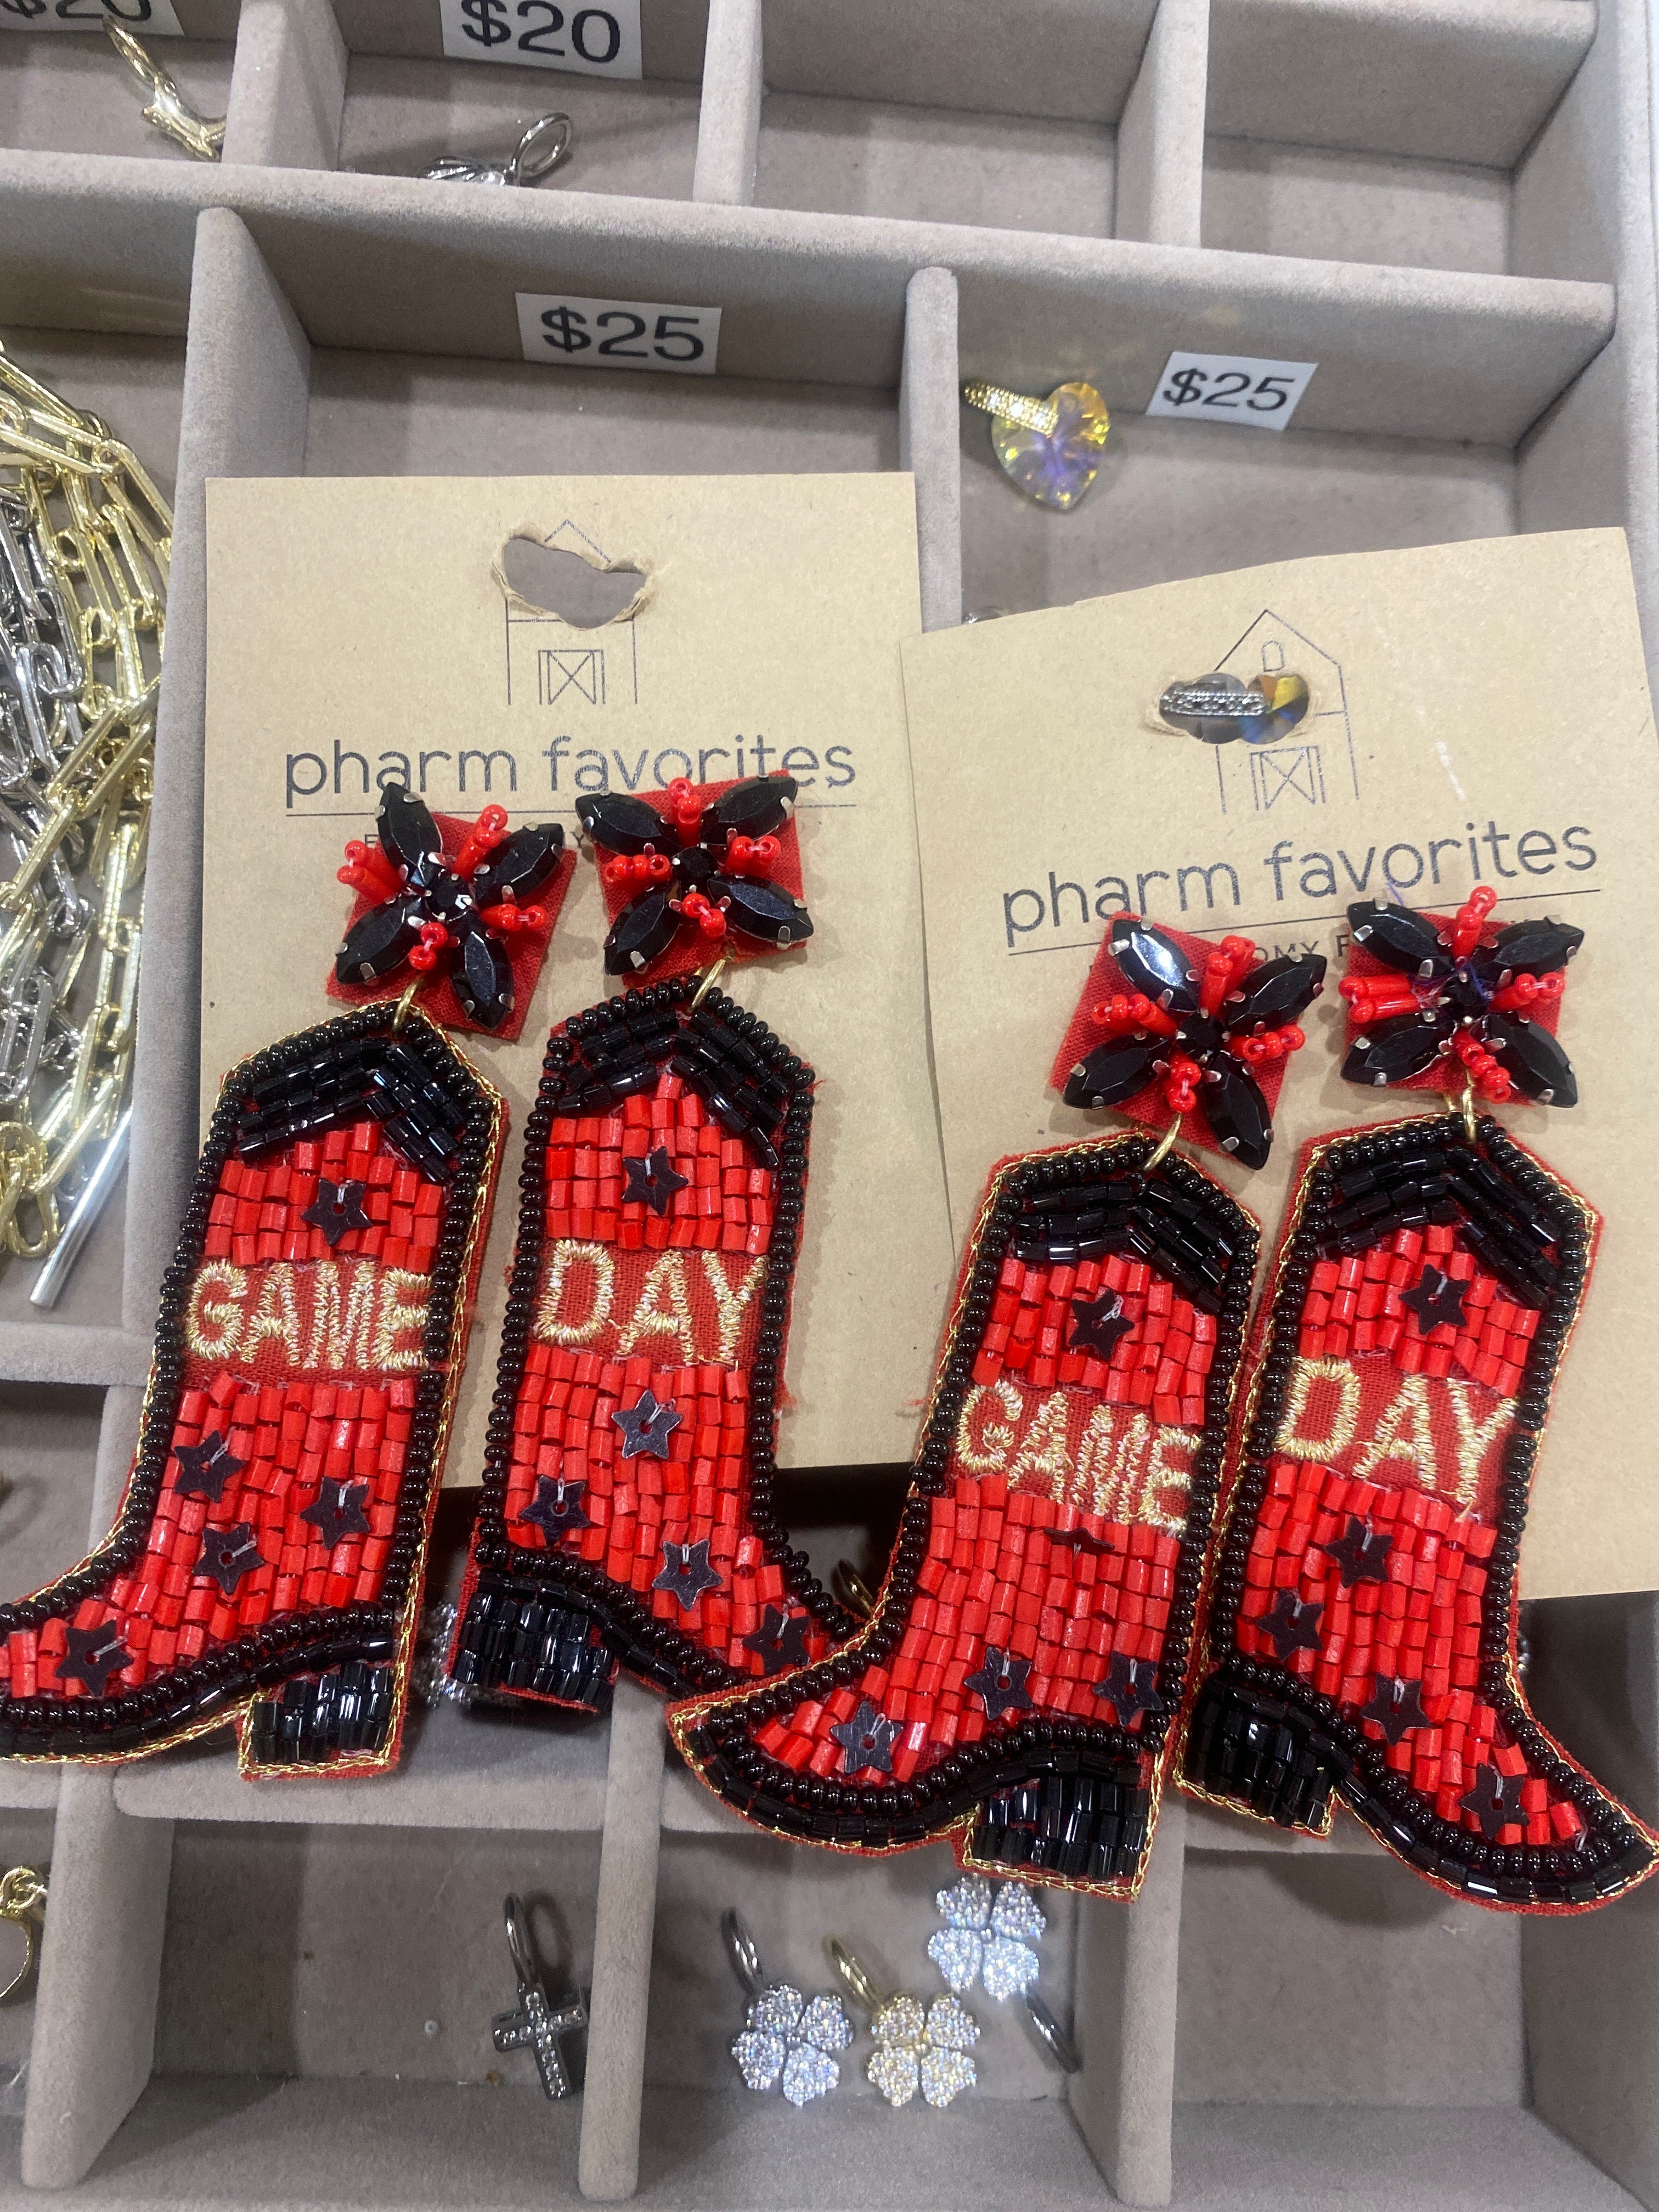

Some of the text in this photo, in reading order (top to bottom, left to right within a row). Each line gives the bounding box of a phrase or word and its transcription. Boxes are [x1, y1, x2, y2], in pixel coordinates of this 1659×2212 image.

[461, 0, 620, 63] $20
[540, 305, 704, 363] $25
[1162, 367, 1297, 413] $25
[286, 735, 855, 809] pharm favorites
[1003, 821, 1598, 946] pharm favorites
[187, 1258, 432, 1372] GAME
[534, 1238, 768, 1367] DAY
[956, 1379, 1203, 1536] GAME
[1274, 1353, 1519, 1508] DAY
